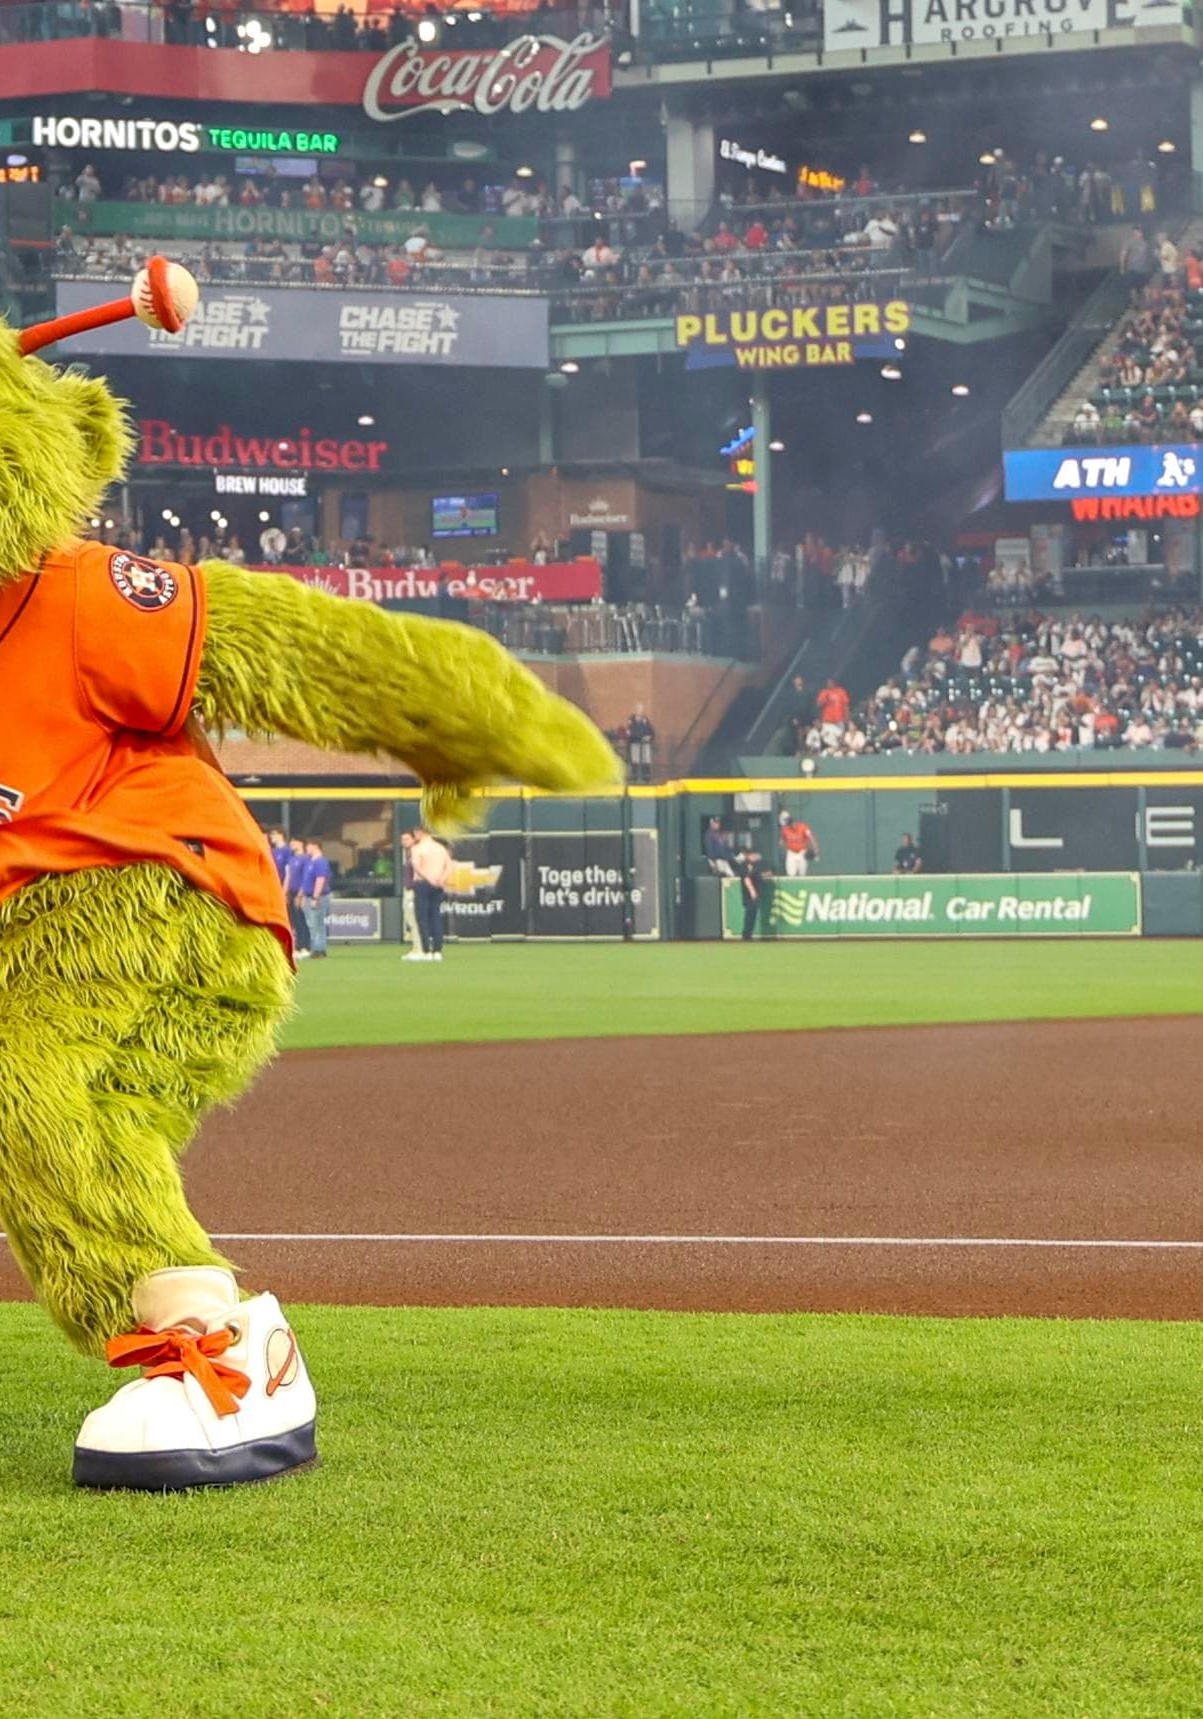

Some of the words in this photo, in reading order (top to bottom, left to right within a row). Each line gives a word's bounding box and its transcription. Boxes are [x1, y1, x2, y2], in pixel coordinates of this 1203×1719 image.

[940, 19, 1073, 43] ROOFING
[363, 32, 612, 122] Coca-Cola
[32, 116, 200, 151] HORNITOS
[209, 127, 292, 151] TEQUILA
[297, 132, 338, 153] BAR
[189, 299, 244, 325] ASE
[340, 304, 433, 331] CHASE
[676, 301, 910, 346] PLUCKERS
[185, 323, 270, 349] FIGHT
[340, 330, 377, 349] THE
[377, 329, 459, 355] FIGHT
[735, 346, 799, 367] WING
[806, 341, 853, 364] BAR
[137, 419, 389, 471] Budweiser
[215, 474, 257, 494] BREW
[259, 476, 308, 496] HOUSE
[1053, 457, 1132, 489] ATH
[347, 567, 535, 600] Budweser
[539, 886, 579, 906] let's
[583, 886, 643, 906] drive
[806, 891, 934, 922] National
[945, 897, 995, 921] Car
[997, 895, 1092, 920] Rental
